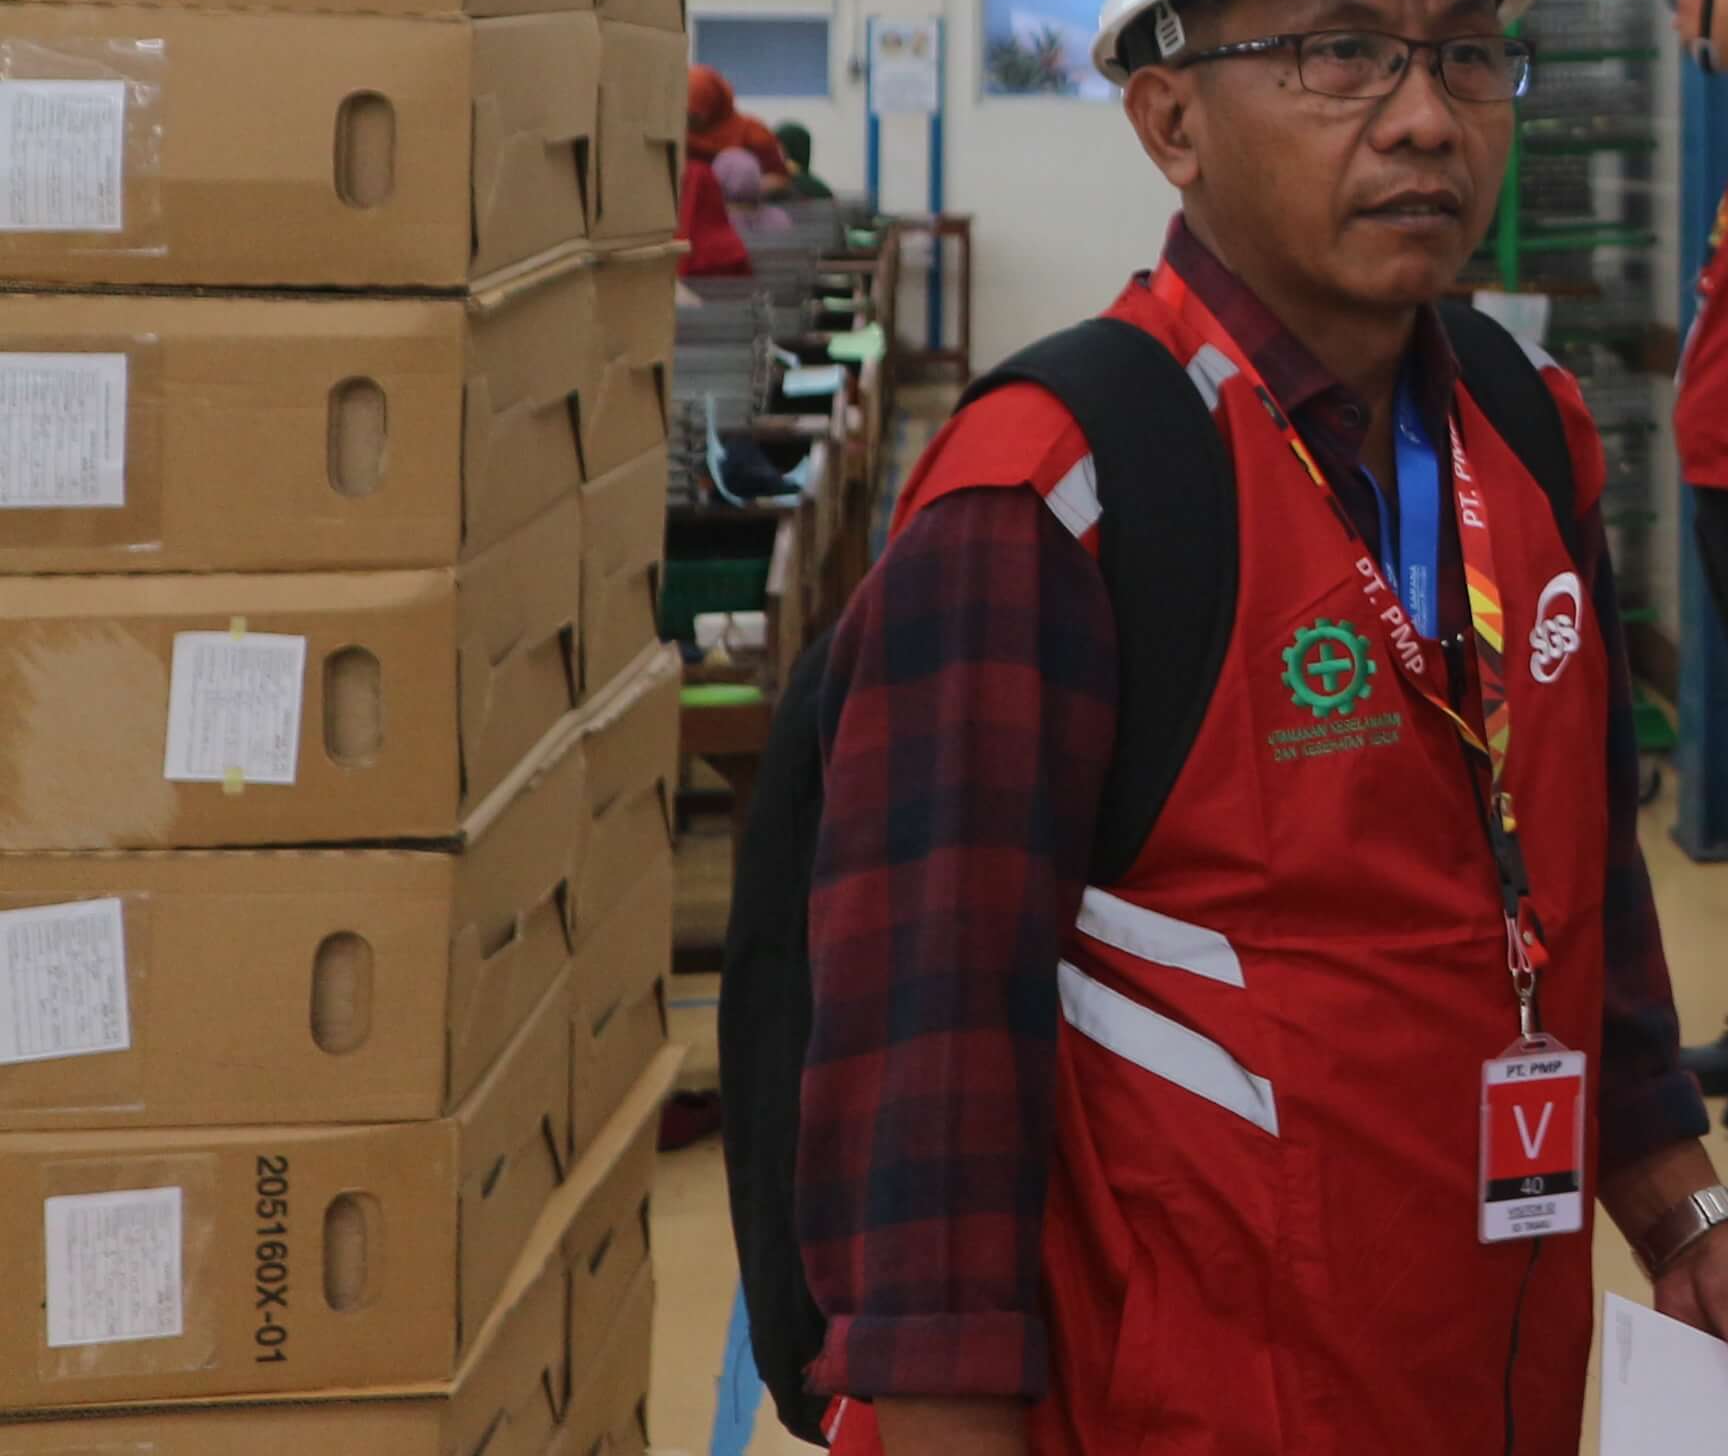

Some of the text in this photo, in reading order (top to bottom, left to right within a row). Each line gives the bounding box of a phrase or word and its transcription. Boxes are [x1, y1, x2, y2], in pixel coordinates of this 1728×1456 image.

[1448, 412, 1487, 530] PT. PM
[1354, 556, 1428, 676] PT. PMP
[1529, 1059, 1563, 1075] PMP
[1512, 1100, 1555, 1161] V
[255, 1154, 289, 1365] 205160X-01
